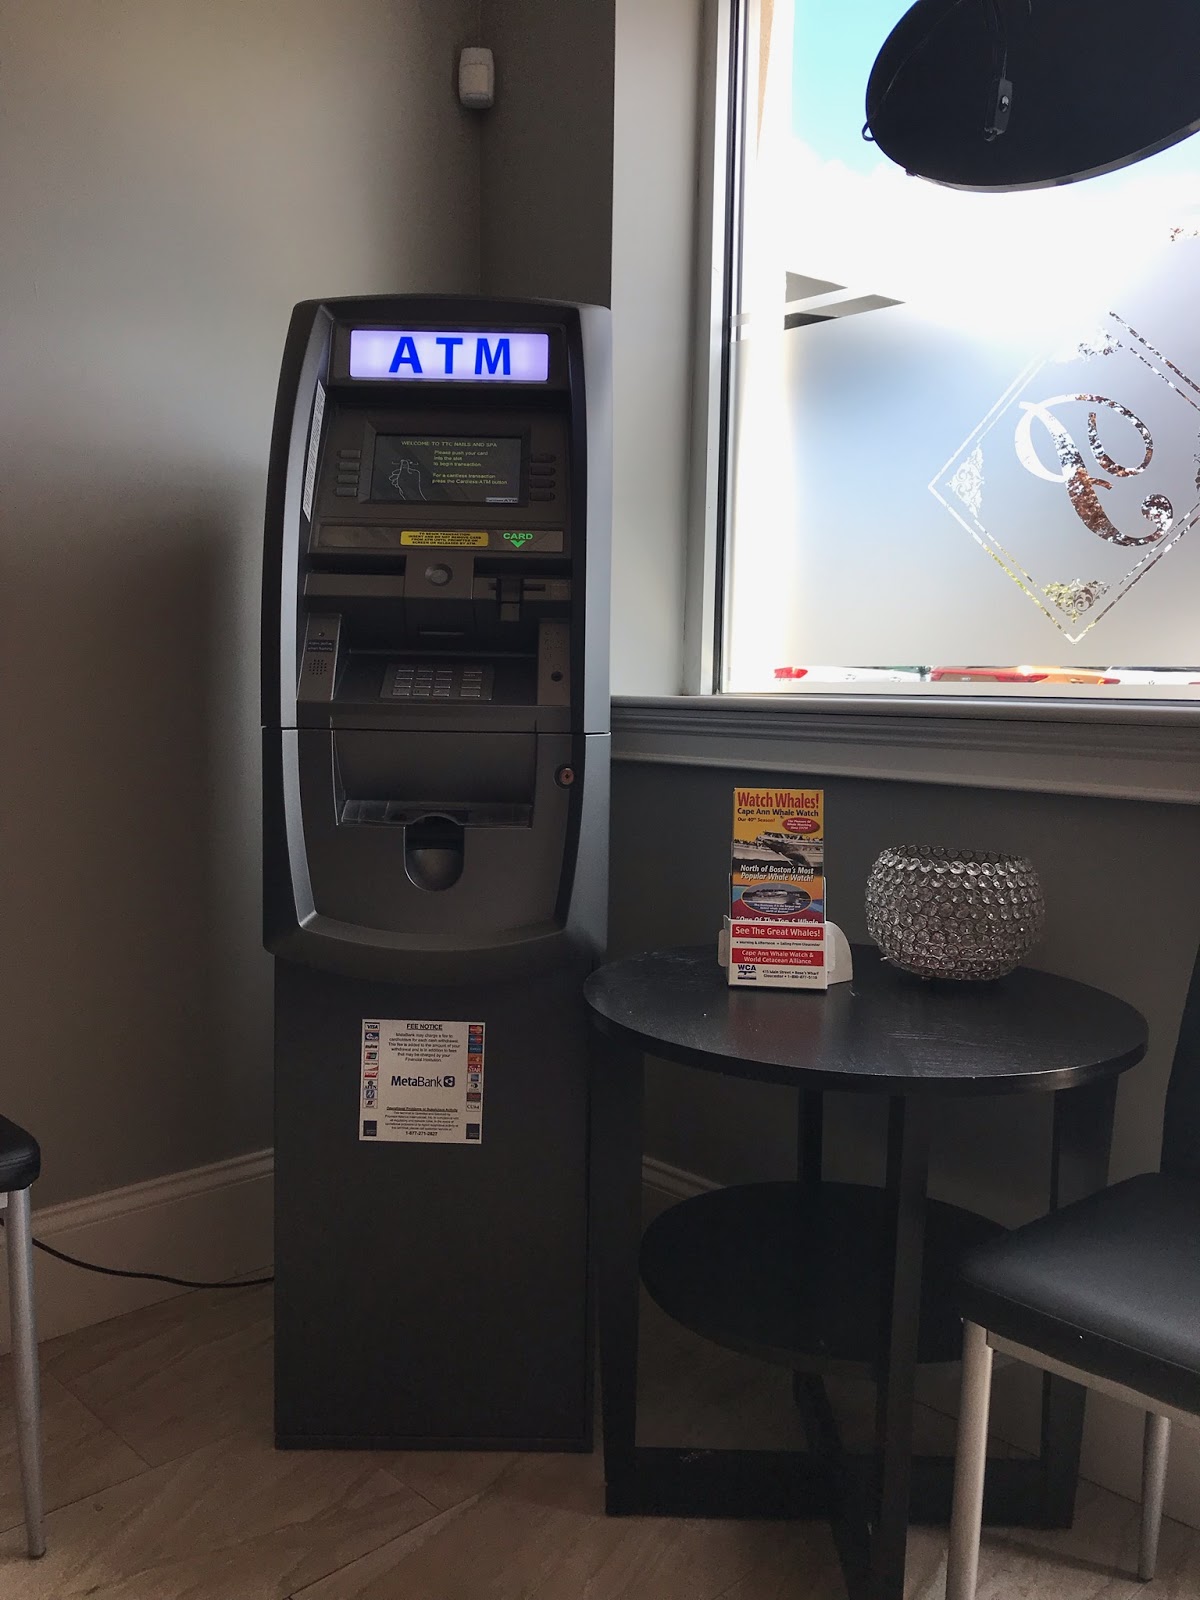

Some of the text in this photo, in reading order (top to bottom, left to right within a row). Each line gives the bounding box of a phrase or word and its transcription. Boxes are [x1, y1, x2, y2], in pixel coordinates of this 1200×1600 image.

[389, 336, 511, 376] ATM
[503, 532, 534, 540] CARD
[738, 792, 819, 809] Watch Whales!
[738, 808, 754, 816] Cape
[741, 872, 767, 881] Popular
[391, 1076, 443, 1087] MetaBank
